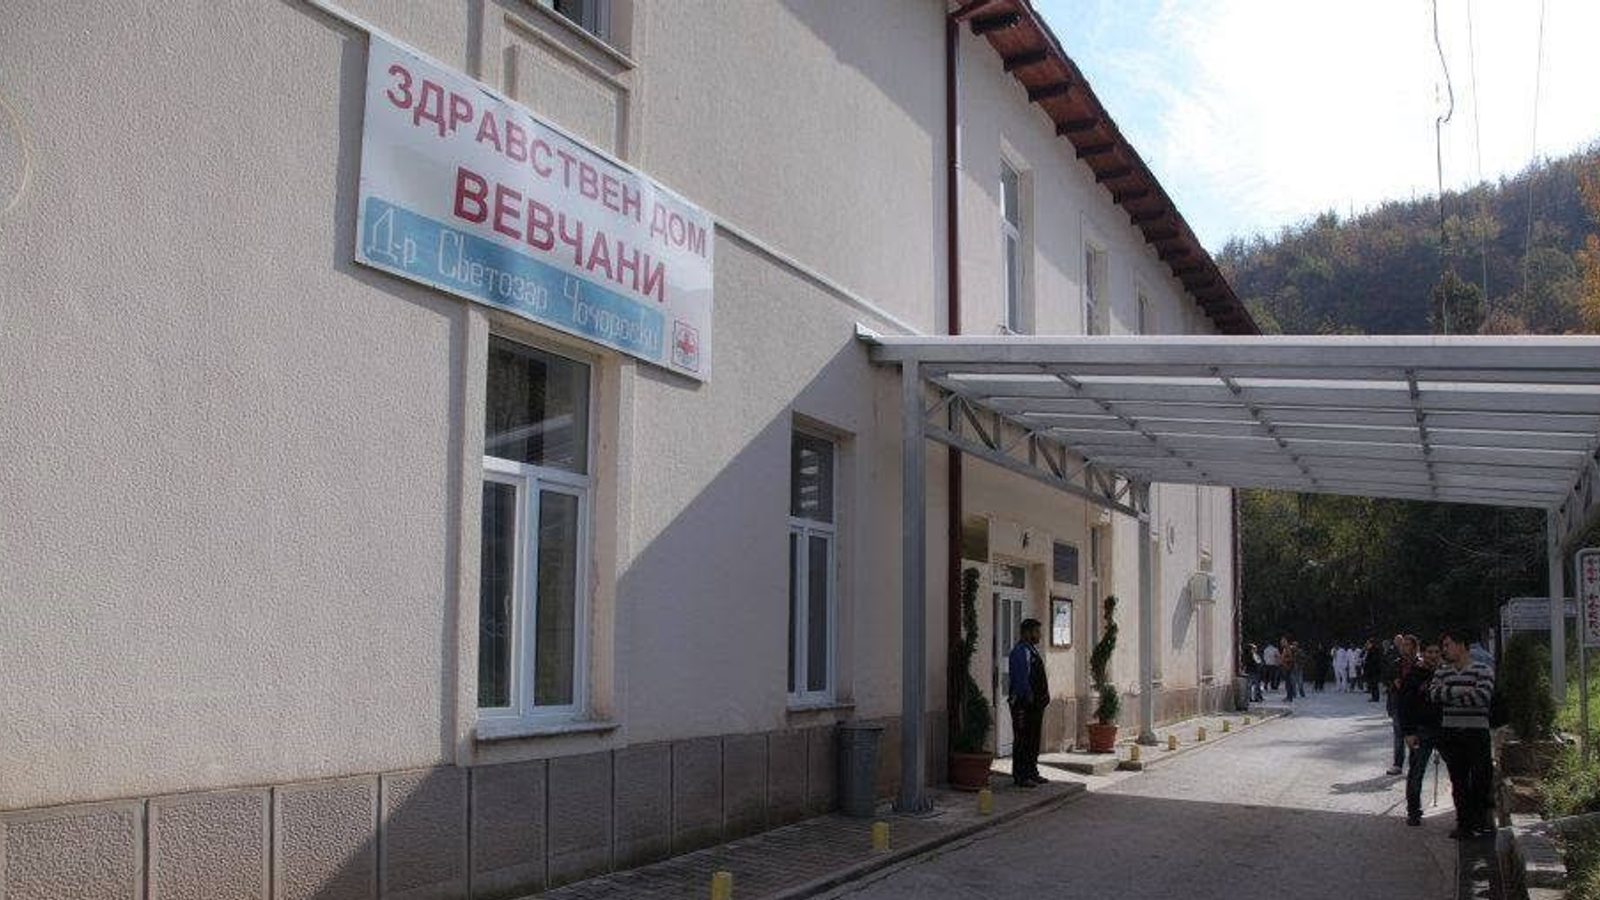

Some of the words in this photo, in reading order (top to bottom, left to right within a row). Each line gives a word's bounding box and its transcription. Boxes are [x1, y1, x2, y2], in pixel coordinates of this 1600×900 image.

[386, 64, 642, 223] ЗДРАВСТВЕН
[650, 203, 706, 258] ДОМ
[367, 207, 416, 270] Д-р
[453, 166, 665, 302] ВЕВЧАНИ
